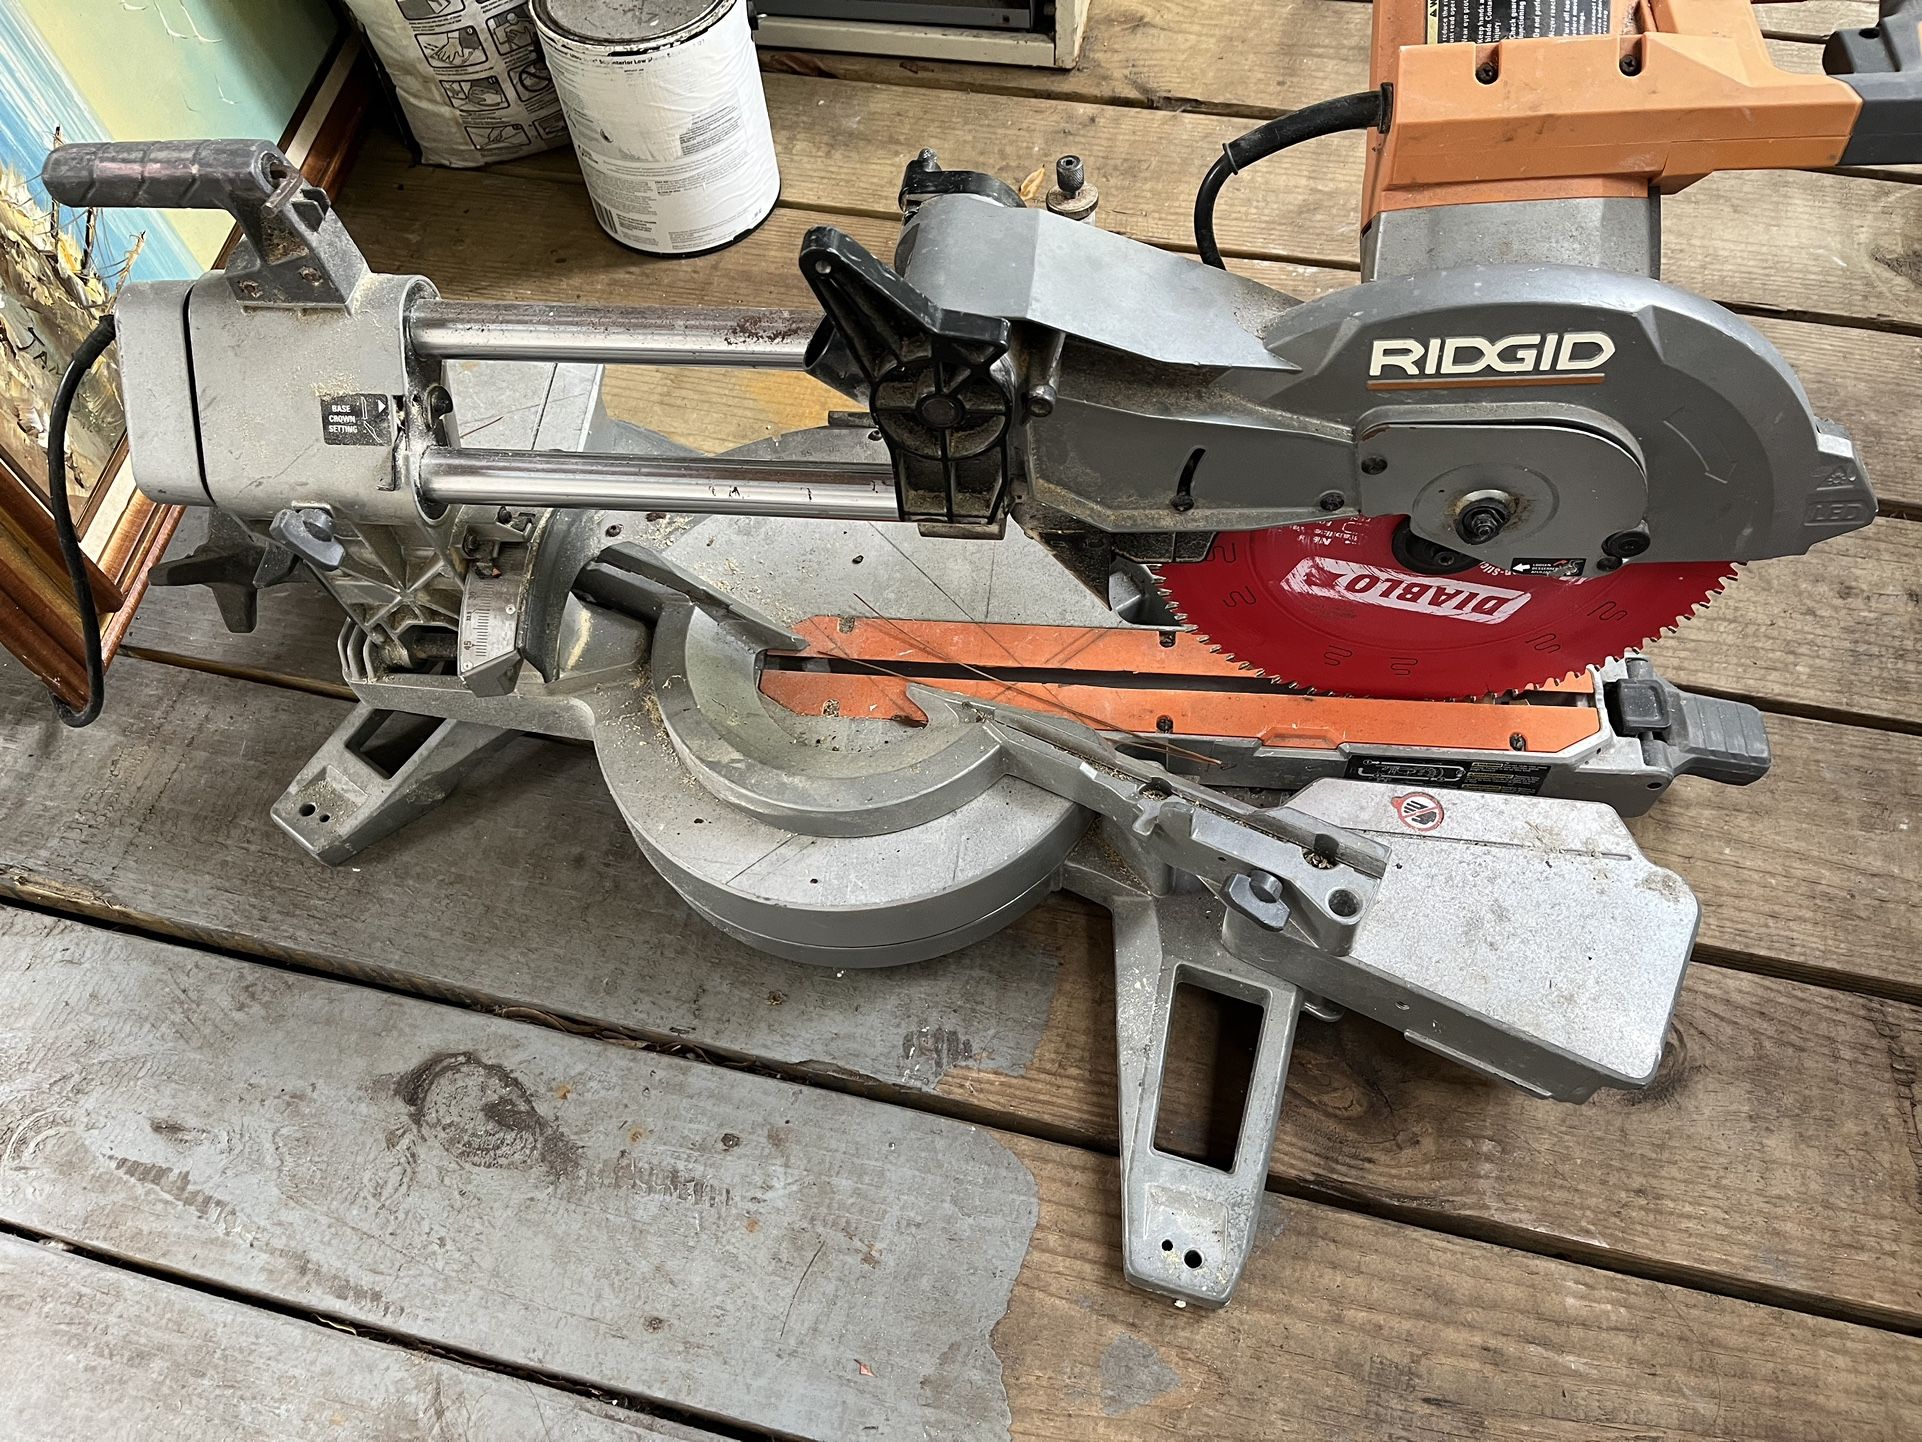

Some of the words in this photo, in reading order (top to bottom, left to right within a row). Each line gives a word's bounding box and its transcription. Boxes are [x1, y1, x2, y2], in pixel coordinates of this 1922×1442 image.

[1518, 1, 1526, 38] functioning
[1477, 26, 1485, 43] Keep
[1509, 18, 1517, 39] Check
[1533, 28, 1540, 38] Do
[1369, 331, 1617, 376] RIDGID
[331, 404, 351, 413] BASE
[328, 414, 357, 424] CROWN
[328, 424, 358, 433] SETTING
[1343, 573, 1514, 616] DIABLO
[463, 640, 472, 651] 45
